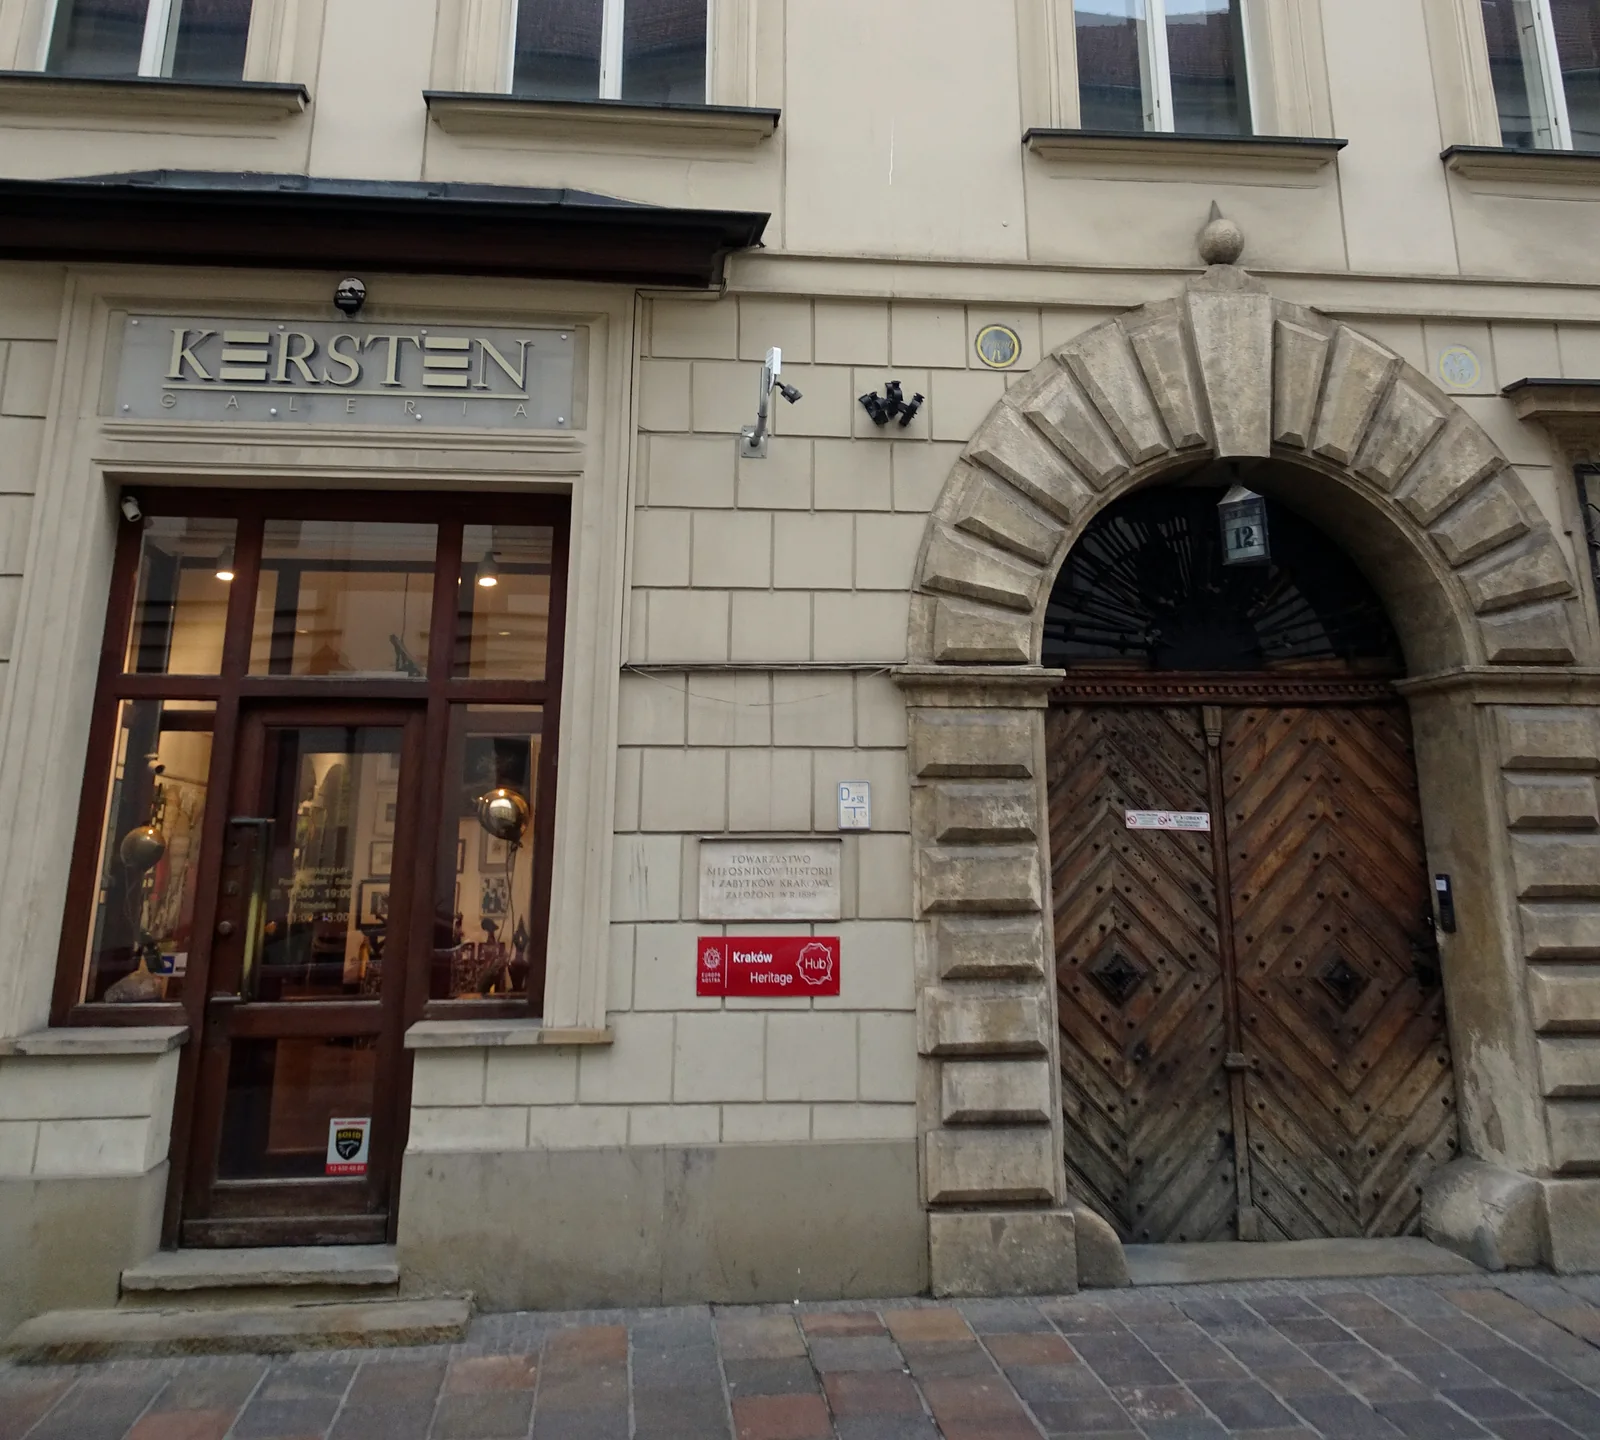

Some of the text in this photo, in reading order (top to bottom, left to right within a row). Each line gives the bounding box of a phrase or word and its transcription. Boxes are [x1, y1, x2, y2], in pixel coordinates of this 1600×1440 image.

[164, 327, 532, 391] KERSTEN
[160, 393, 528, 418] GALERIA
[1234, 526, 1254, 549] 12
[731, 855, 811, 864] TOWARZYSTWO
[785, 866, 833, 876] HISTORII
[733, 951, 773, 963] Kraków
[805, 957, 826, 970] Hub
[750, 971, 793, 986] Heritage
